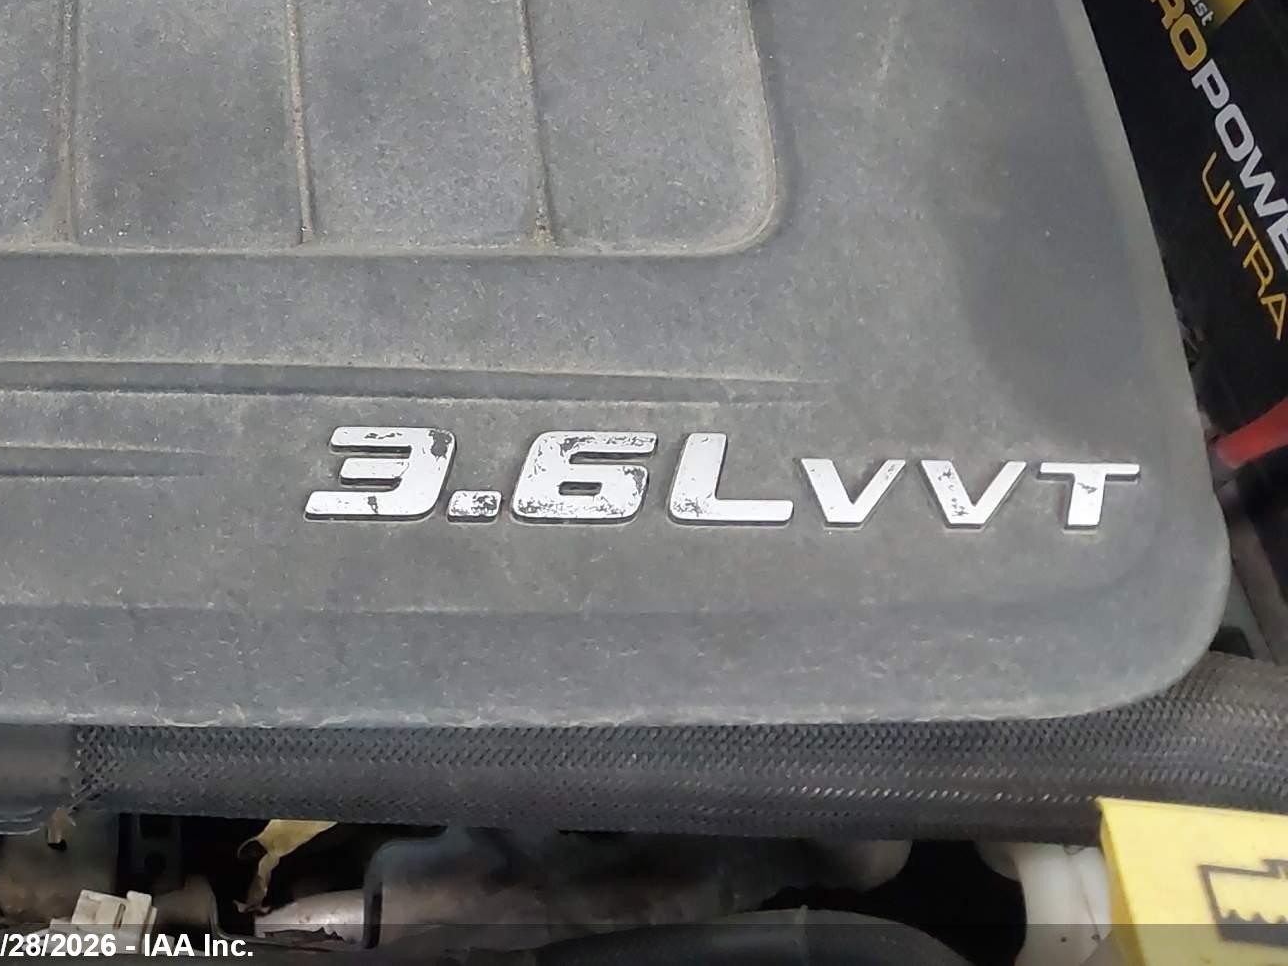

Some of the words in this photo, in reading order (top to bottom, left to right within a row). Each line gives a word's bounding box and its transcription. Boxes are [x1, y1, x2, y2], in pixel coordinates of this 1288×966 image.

[1202, 151, 1287, 341] ULTRA
[304, 426, 795, 524] 3.6L
[800, 458, 1142, 530] VVT
